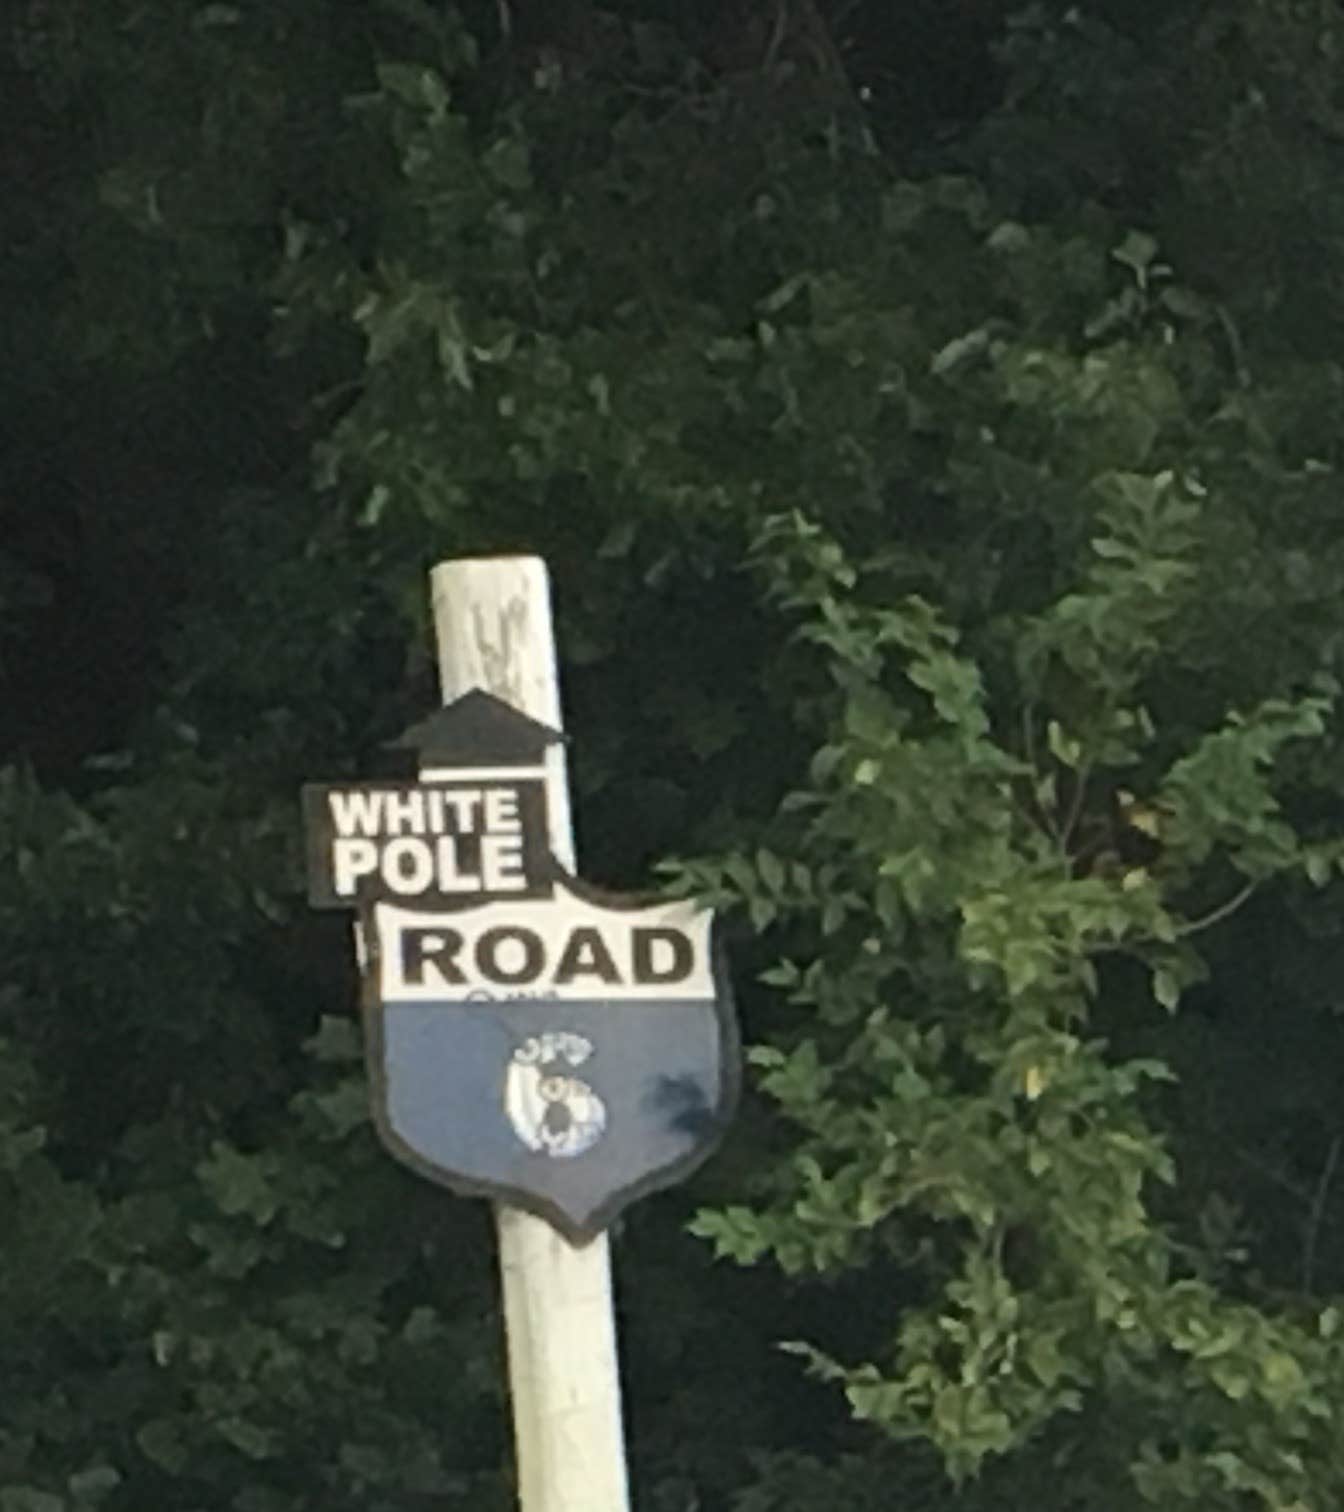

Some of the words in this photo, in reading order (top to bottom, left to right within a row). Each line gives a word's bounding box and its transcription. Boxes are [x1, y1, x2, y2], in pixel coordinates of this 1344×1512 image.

[329, 789, 522, 836] WHITE
[333, 835, 527, 895] POLE
[400, 926, 695, 986] ROAD
